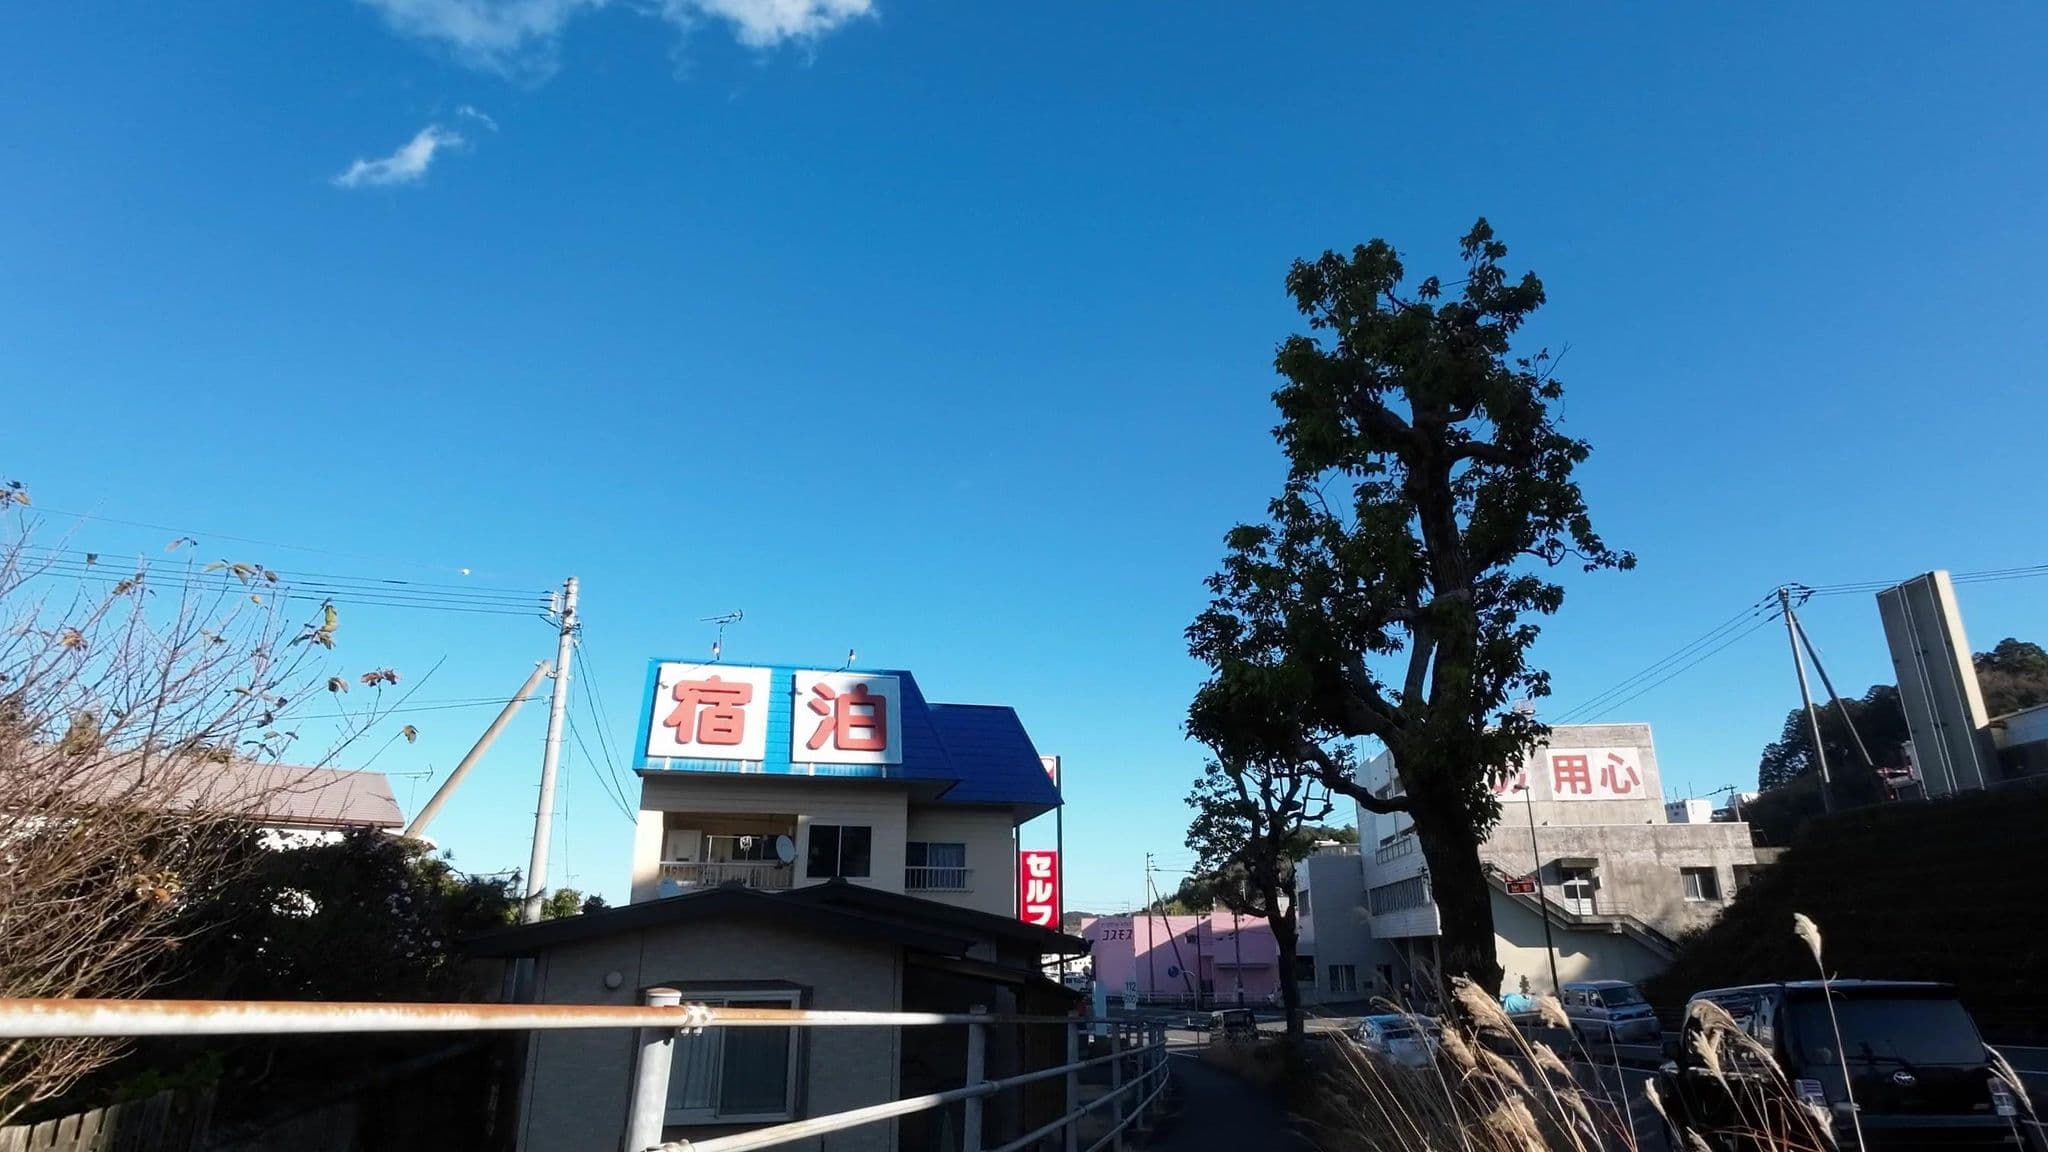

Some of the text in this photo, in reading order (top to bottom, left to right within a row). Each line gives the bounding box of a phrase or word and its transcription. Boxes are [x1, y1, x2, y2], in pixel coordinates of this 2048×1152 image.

[663, 675, 886, 752] 宿泊
[1026, 854, 1053, 926] セルフ
[1102, 929, 1133, 941] コスモス
